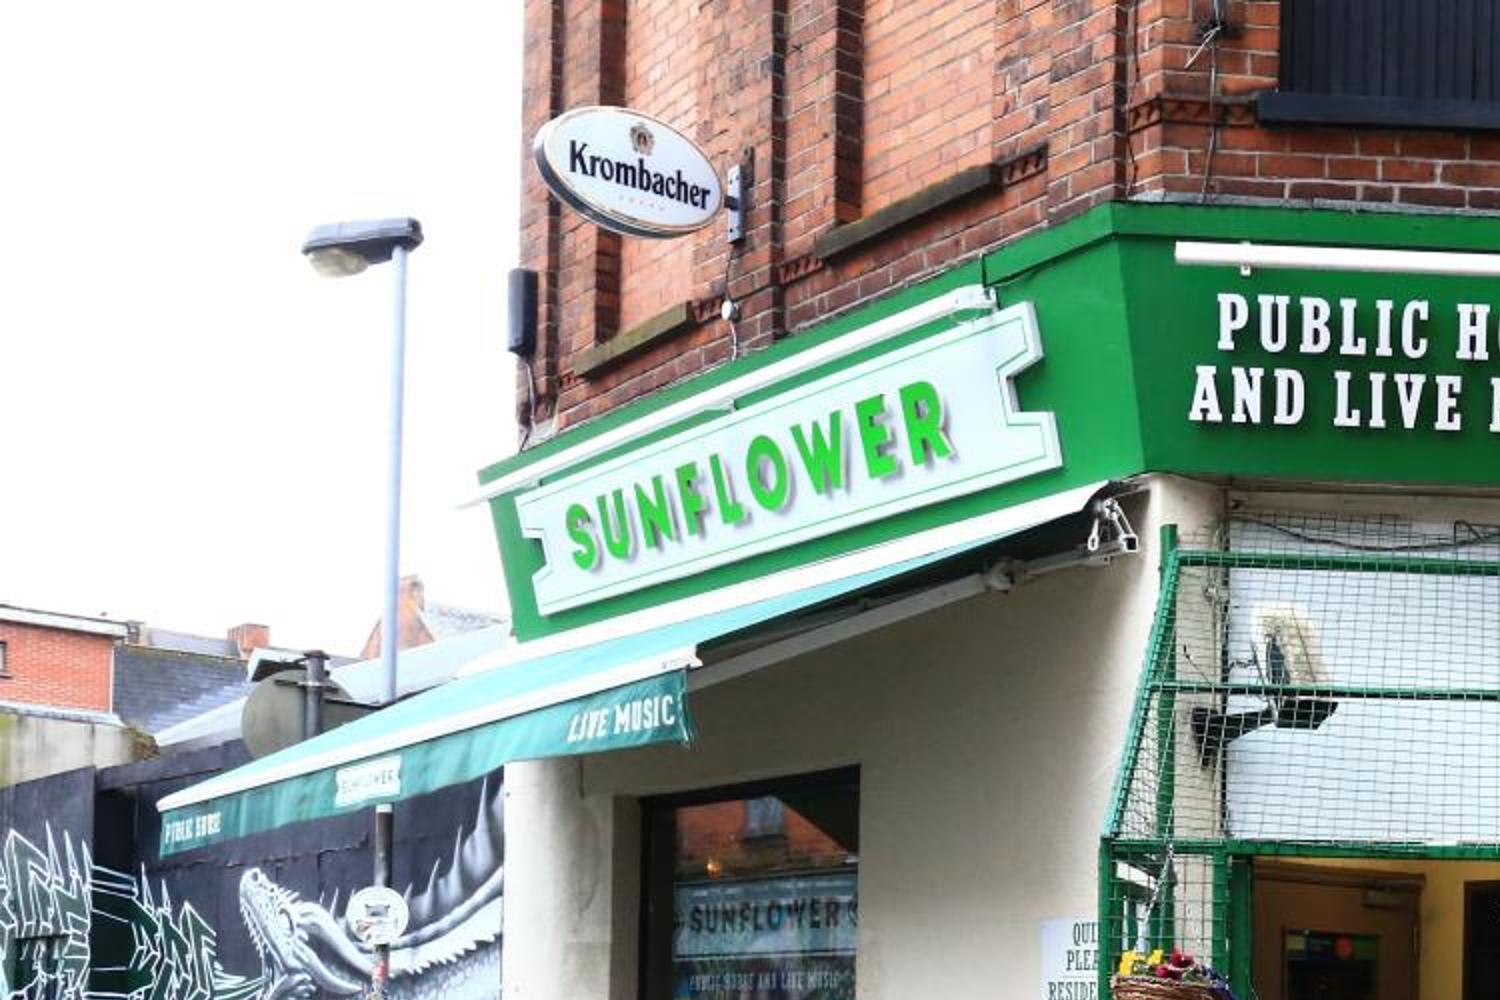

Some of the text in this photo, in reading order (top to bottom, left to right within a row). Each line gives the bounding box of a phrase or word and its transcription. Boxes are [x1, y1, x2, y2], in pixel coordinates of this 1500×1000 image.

[569, 140, 710, 209] Krombacher
[1217, 293, 1430, 359] PUBLIC
[1188, 365, 1306, 425] AND
[1333, 370, 1462, 431] LIVE
[564, 380, 954, 572] SUNFLOWER
[567, 694, 675, 743] LIVE MUSIC
[690, 898, 840, 933] SUNFLOWER
[1073, 922, 1099, 946] QUI
[1066, 949, 1099, 971] PLEA
